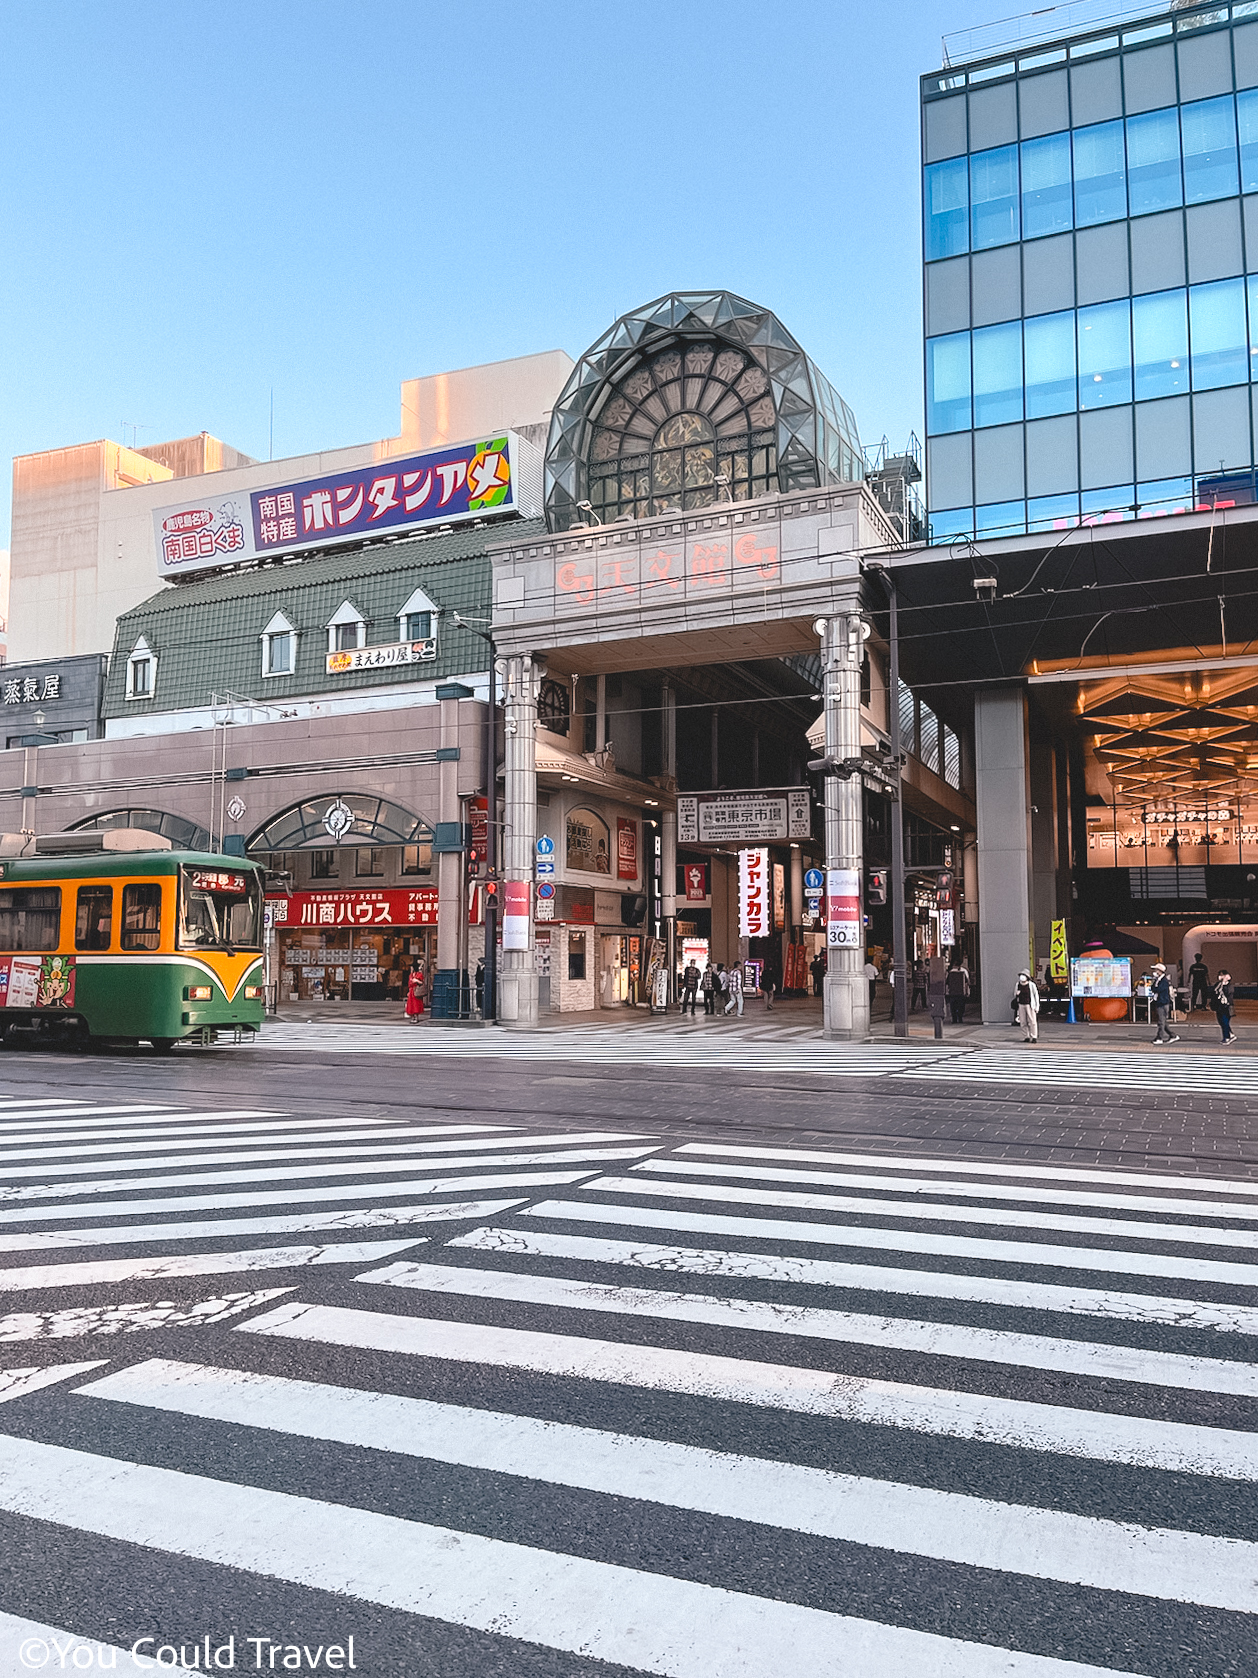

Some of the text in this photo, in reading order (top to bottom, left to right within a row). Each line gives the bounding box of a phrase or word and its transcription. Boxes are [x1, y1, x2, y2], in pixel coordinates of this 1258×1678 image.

[258, 492, 295, 519] 南国
[302, 453, 509, 533] ボンタンアメ
[165, 510, 211, 532] 鹿児島名物
[260, 519, 298, 544] 特産
[162, 523, 244, 564] 南国白くま
[600, 543, 729, 595] 天文館
[354, 646, 409, 667] まえわり屋
[4, 674, 60, 705] 蒸氣屋
[728, 808, 782, 823] 東京市場
[192, 871, 201, 887] 2
[746, 852, 761, 933] ジャンカラ
[300, 902, 392, 925] 川商ハウス
[1053, 922, 1066, 975] イベント
